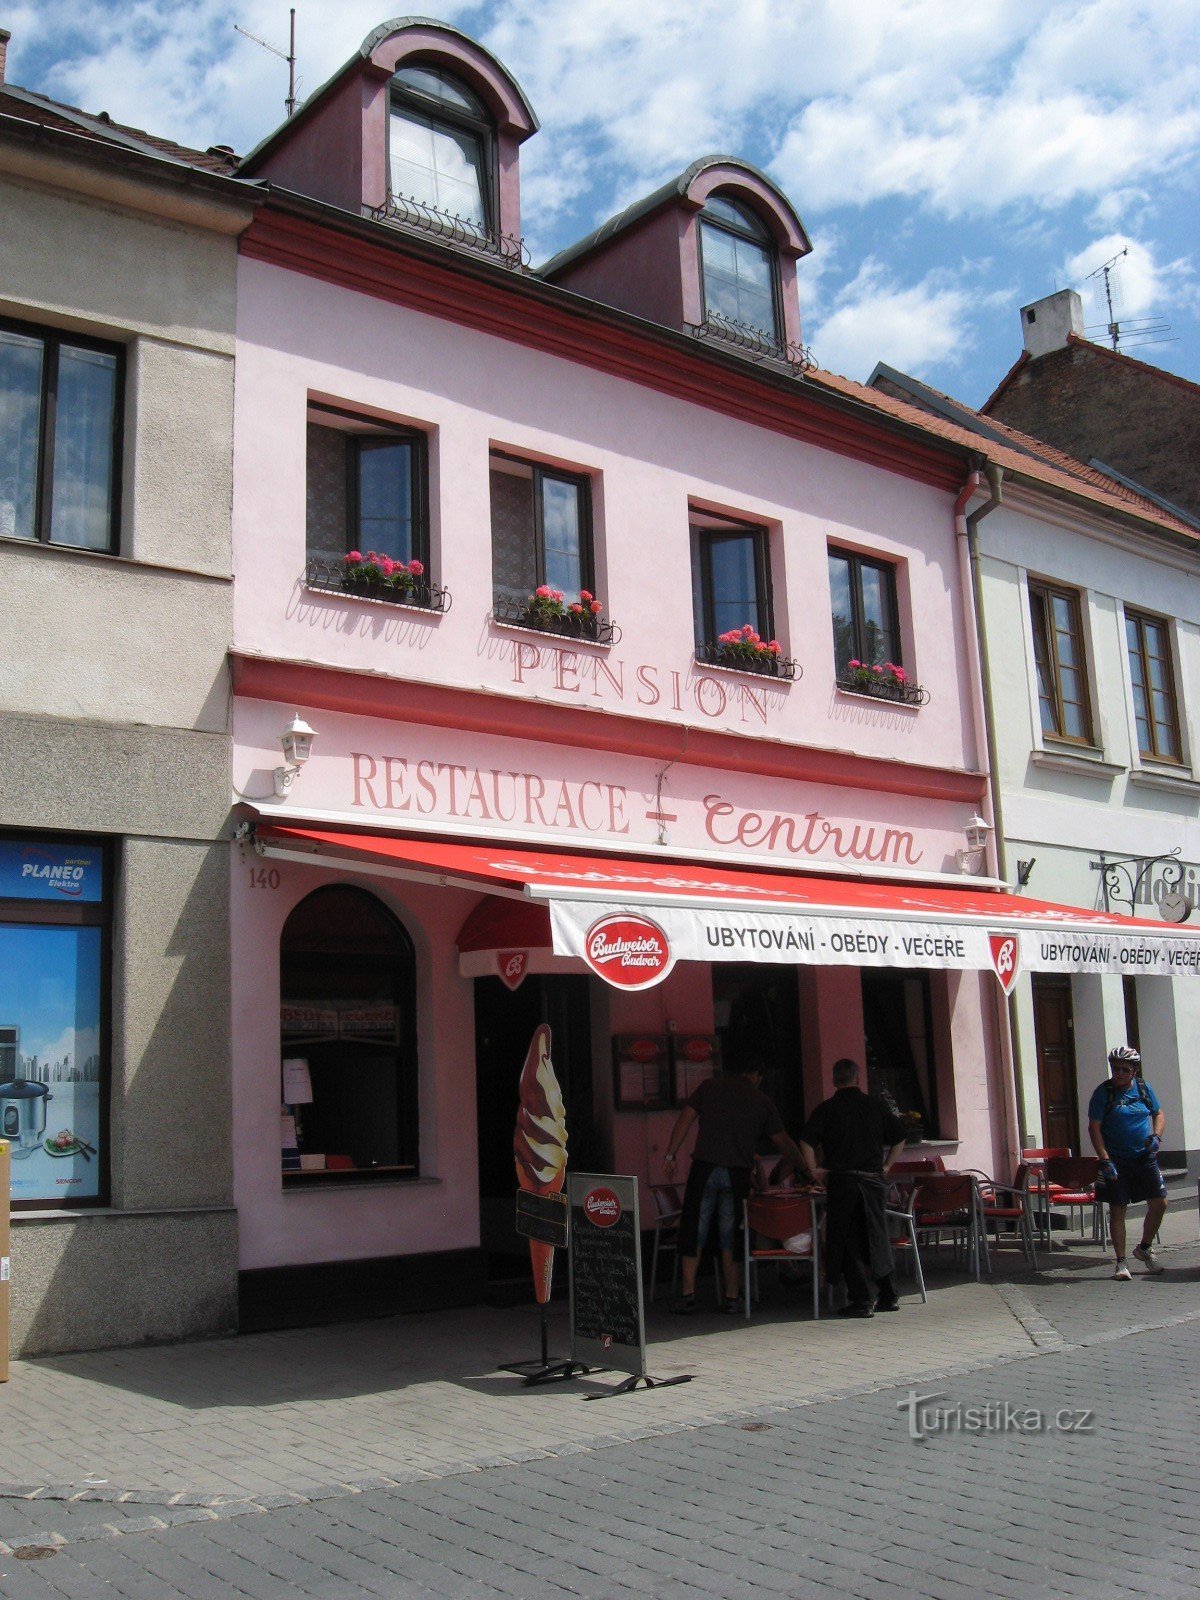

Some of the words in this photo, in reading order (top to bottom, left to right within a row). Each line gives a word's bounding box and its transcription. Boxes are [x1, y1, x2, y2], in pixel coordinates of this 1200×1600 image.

[511, 639, 768, 725] PENSION
[350, 752, 631, 834] RESTAURACE
[703, 794, 923, 865] Centrum
[22, 863, 84, 880] PLANEO
[250, 867, 281, 890] 140
[48, 879, 80, 888] Elektro
[590, 932, 660, 959] Budweiser
[706, 926, 815, 952] UBYTOVÁNÍ
[831, 930, 889, 955] OBĚDY
[902, 933, 966, 958] VEČEŘE
[621, 951, 662, 967] Budvar
[1040, 943, 1111, 964] UBYTOVÁNÍ
[1120, 944, 1160, 966] OBĚDY
[55, 1177, 83, 1186] SENCOR
